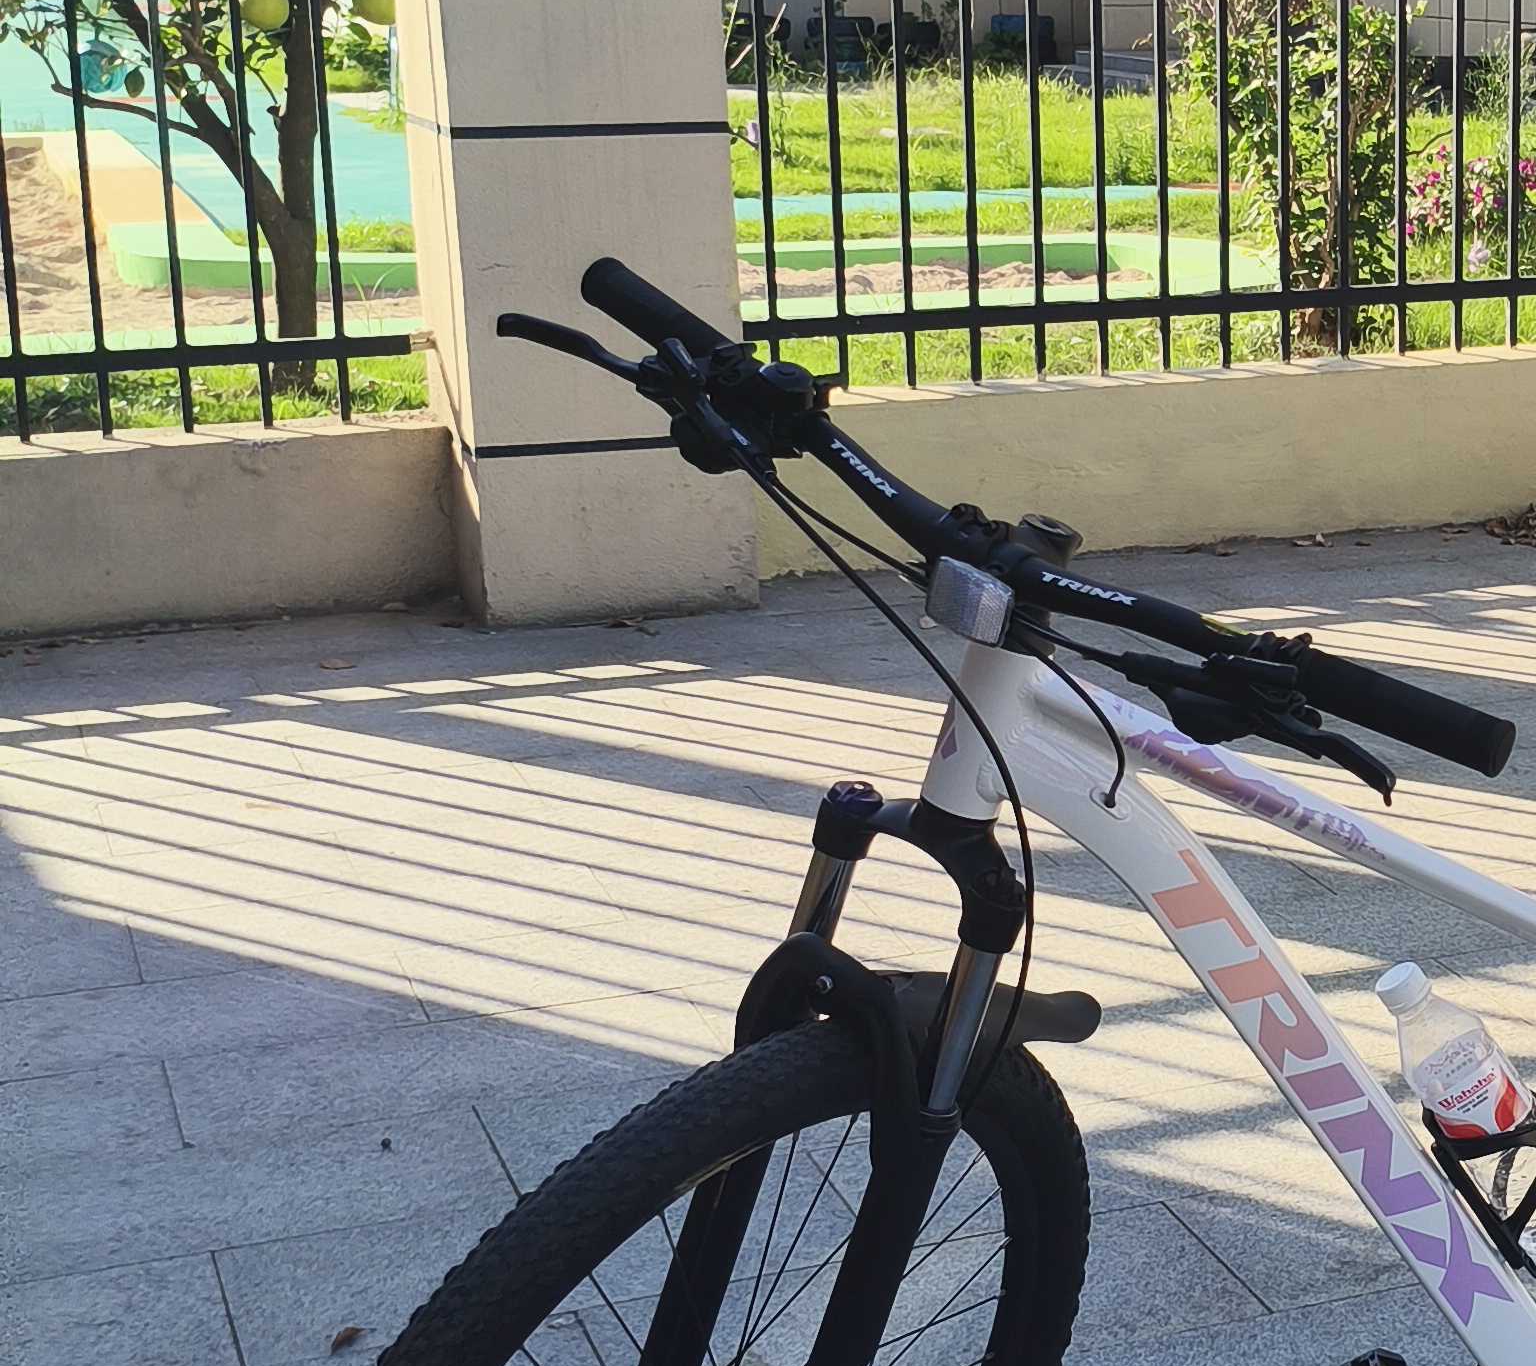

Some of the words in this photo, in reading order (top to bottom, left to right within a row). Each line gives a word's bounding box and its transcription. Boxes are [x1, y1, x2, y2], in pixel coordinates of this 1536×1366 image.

[829, 438, 899, 499] TRINX
[1040, 571, 1139, 606] TRINX
[1150, 848, 1516, 1328] TRINX
[1437, 1072, 1498, 1112] Wahaha
